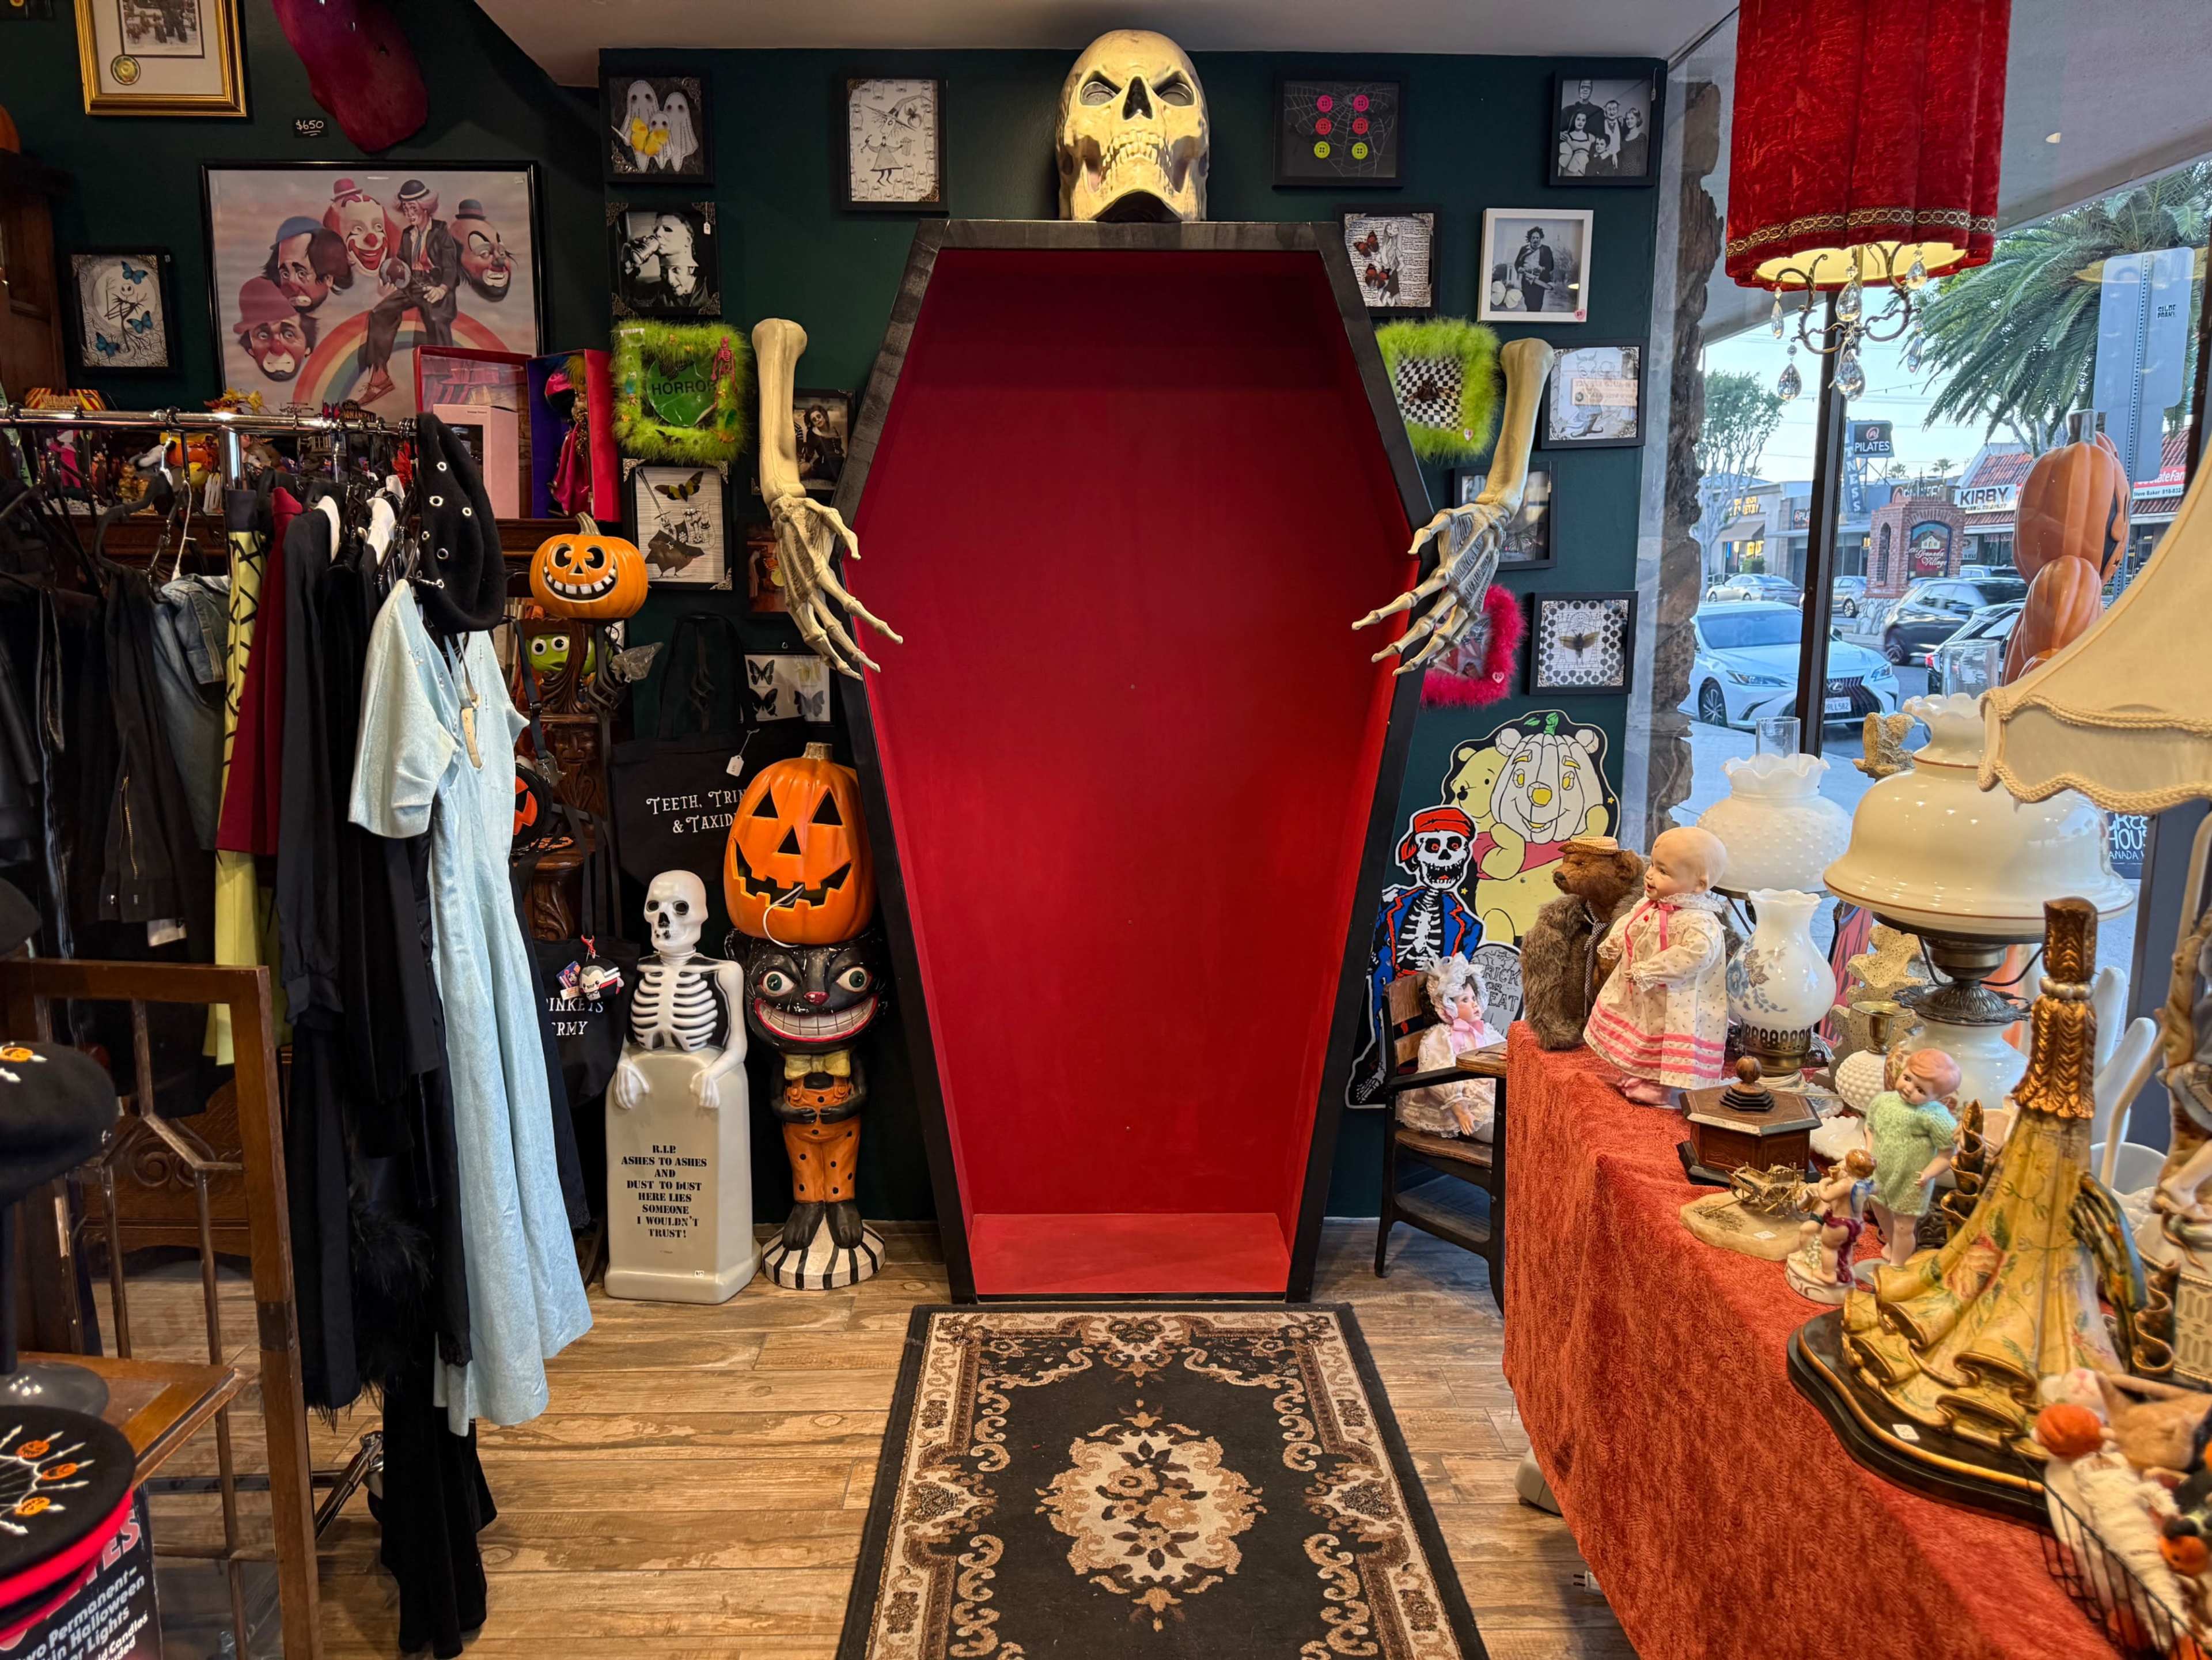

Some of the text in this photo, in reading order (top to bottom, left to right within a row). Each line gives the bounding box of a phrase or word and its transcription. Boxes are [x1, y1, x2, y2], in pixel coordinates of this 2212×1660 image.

[296, 120, 324, 131] $650
[1855, 441, 1890, 452] PILATES
[1845, 433, 1861, 512] ITNESS
[1960, 486, 2009, 505] KIRBY
[1922, 557, 1947, 568] Village
[646, 789, 747, 815] TEETH, TRIN
[673, 813, 735, 833] & TAXID
[2109, 828, 2146, 850] HOU
[2109, 850, 2139, 859] ANADA
[1482, 965, 1521, 986] RICK
[1485, 981, 1502, 993] OR
[1488, 992, 1519, 1012] EAT
[621, 1156, 707, 1167] ASHES TO ASHES
[654, 1169, 676, 1178] AND
[627, 1180, 702, 1191] DUST TO DUST
[638, 1192, 692, 1203] HERE LIES
[642, 1204, 689, 1214] SOMEONE
[637, 1215, 699, 1227] I WOULDN'T
[649, 1228, 687, 1238] TRUST!
[48, 1566, 137, 1650] Permanent-
[70, 1575, 145, 1650] Halloween
[86, 1606, 130, 1653] Lights
